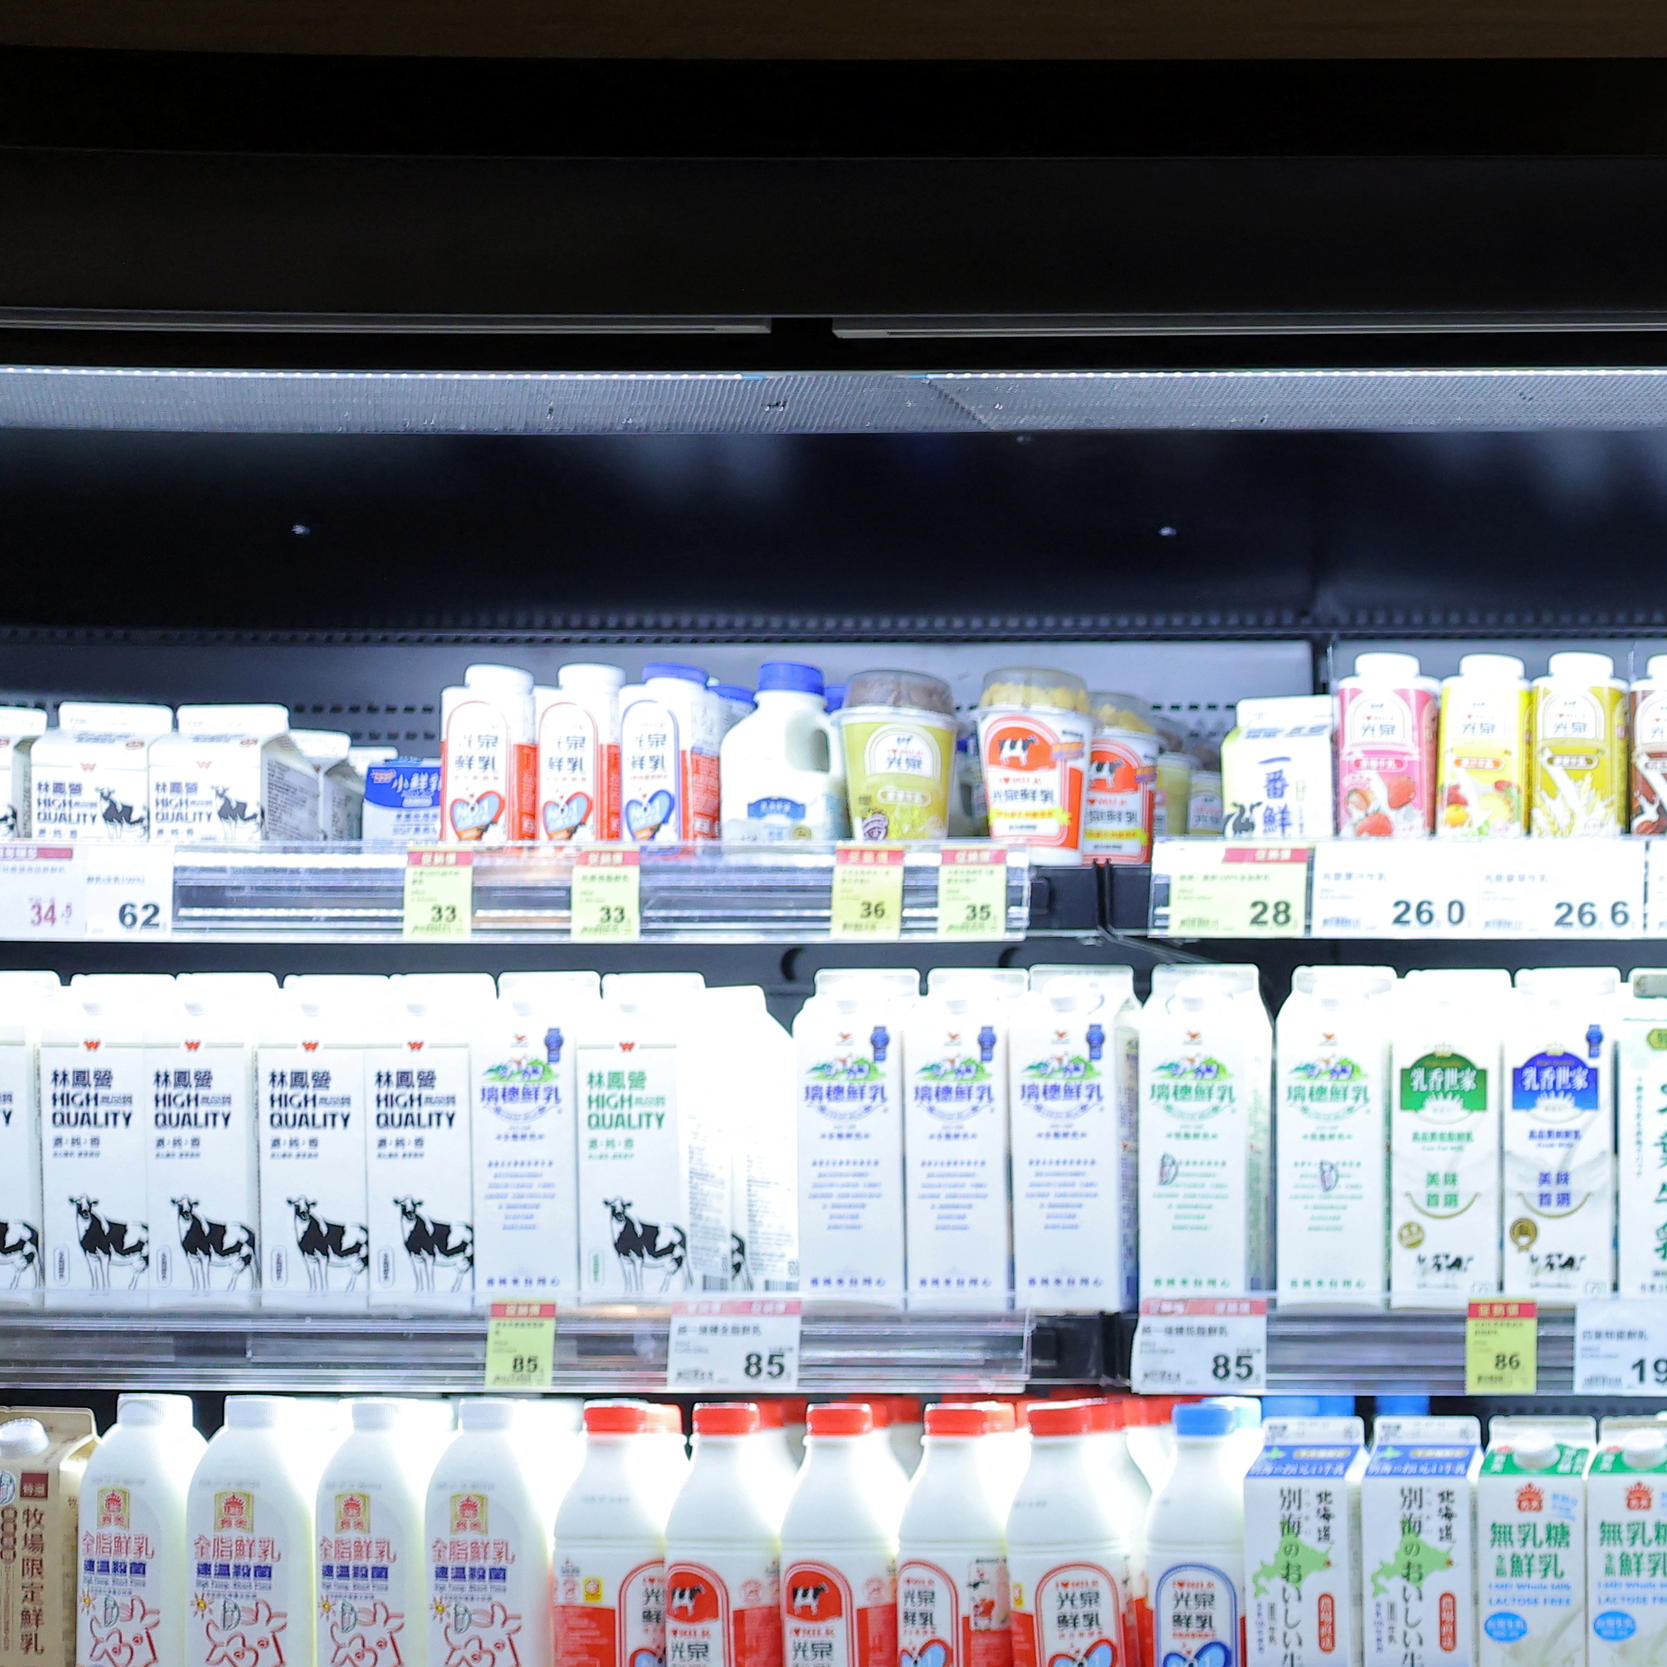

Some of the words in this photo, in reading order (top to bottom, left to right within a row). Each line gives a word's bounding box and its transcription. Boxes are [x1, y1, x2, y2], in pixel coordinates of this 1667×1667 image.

[118, 904, 161, 929] 62
[431, 906, 457, 922] 33
[600, 906, 625, 922] 33
[861, 901, 885, 919] 36
[966, 904, 992, 922] 35
[1250, 900, 1292, 926] 28
[270, 1093, 315, 1109] HIGH
[376, 1093, 421, 1109] HIGH
[52, 1110, 132, 1129] QUALITY
[155, 1110, 231, 1129] QUALITY
[512, 1356, 538, 1373] 85
[744, 1353, 784, 1379] 85
[1213, 1354, 1254, 1380] 85
[1495, 1353, 1520, 1370] 86
[1489, 1521, 1571, 1550] 無乳糖
